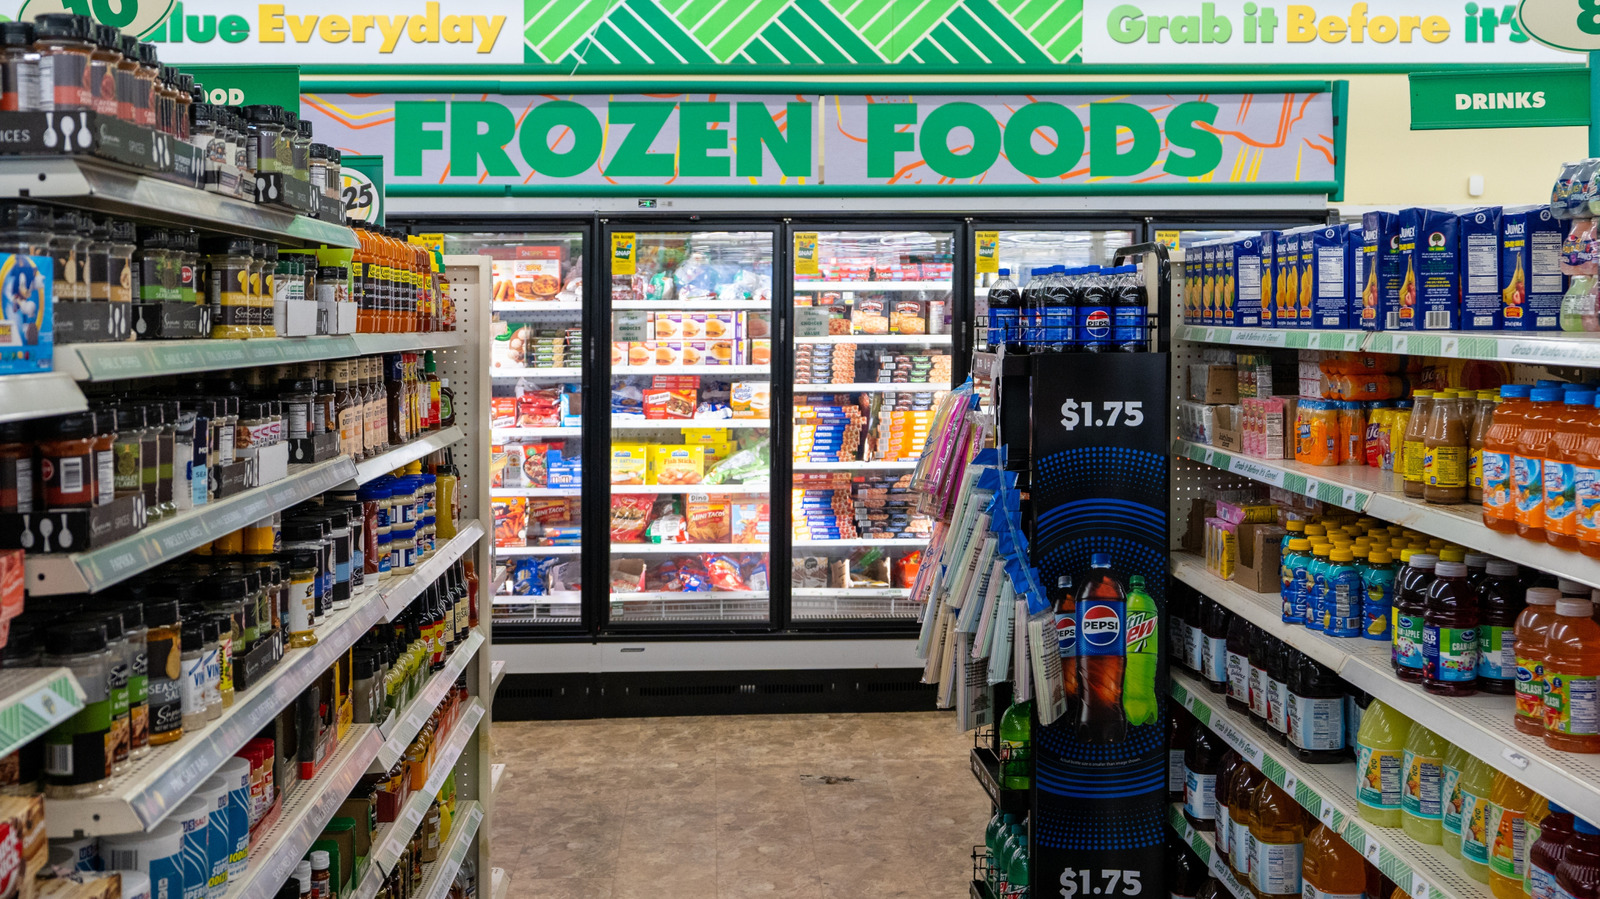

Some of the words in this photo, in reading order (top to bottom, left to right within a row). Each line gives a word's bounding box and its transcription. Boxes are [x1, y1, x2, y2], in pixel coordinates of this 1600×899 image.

[258, 1, 507, 54] Everyday
[1106, 2, 1233, 44] Grab
[1243, 2, 1279, 44] it
[1287, 4, 1451, 44] Before
[203, 88, 245, 106] OD
[1455, 91, 1547, 111] DRINKS
[394, 100, 812, 178] FROZEN
[867, 101, 1223, 178] FOODS
[1505, 223, 1525, 235] JUMEX
[1511, 344, 1530, 355] Grab
[1060, 398, 1144, 432] $1.75
[1234, 461, 1245, 470] Grab
[1248, 464, 1260, 475] Before
[1265, 470, 1278, 480] Gone!
[690, 513, 707, 521] MINI
[1084, 621, 1118, 630] PEPSI
[1127, 617, 1157, 644] ew
[1230, 668, 1246, 679] Balance
[1520, 683, 1542, 695] SPLASH
[1214, 720, 1225, 731] Grab
[1227, 729, 1239, 744] Before
[1244, 743, 1258, 759] Gone!
[1214, 859, 1224, 874] Grab
[1226, 872, 1242, 891] Before
